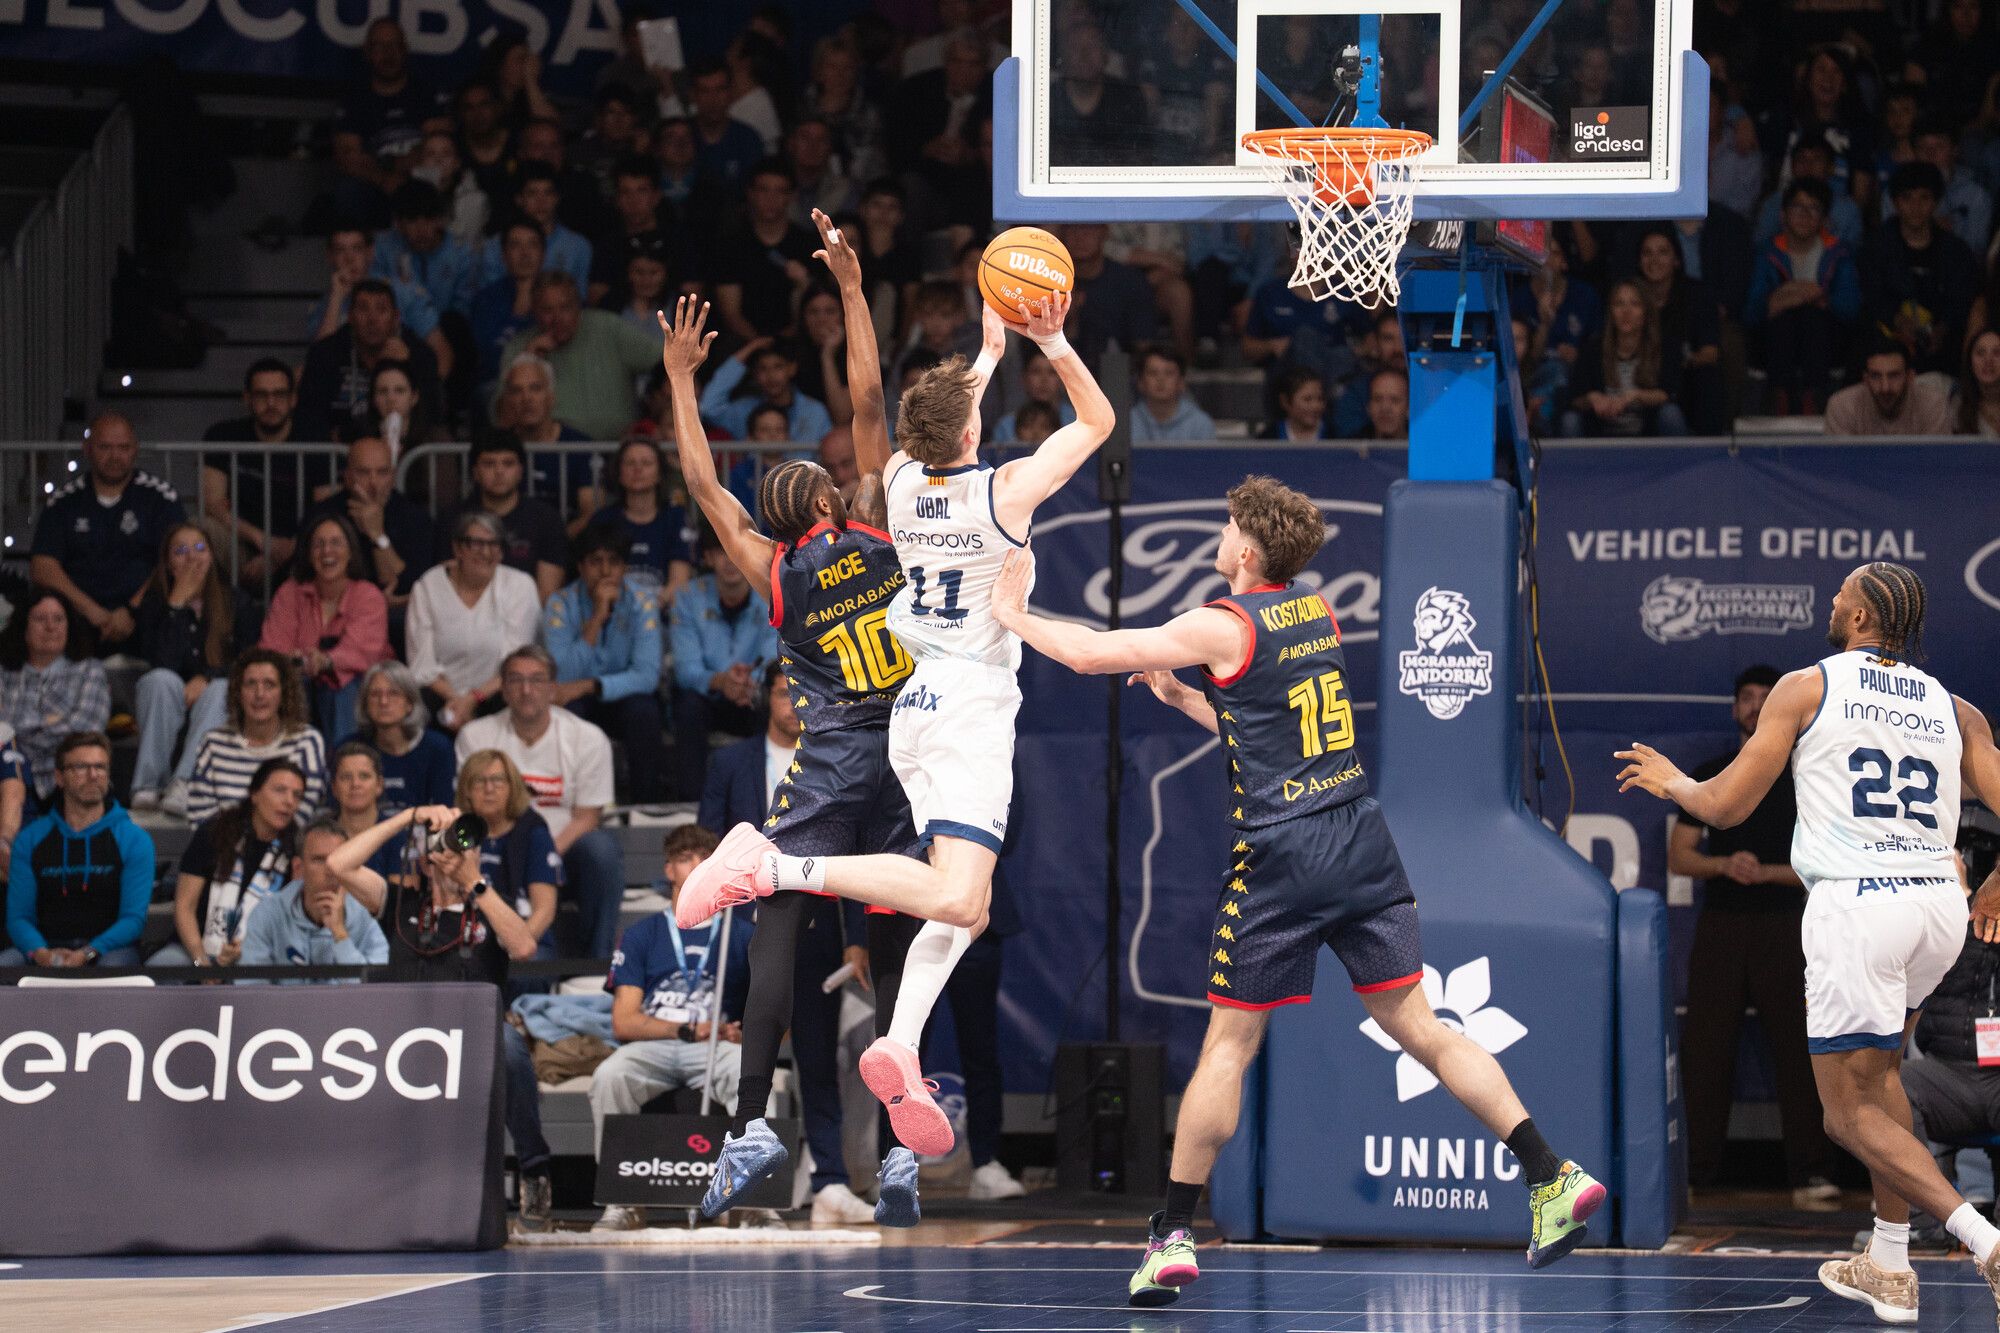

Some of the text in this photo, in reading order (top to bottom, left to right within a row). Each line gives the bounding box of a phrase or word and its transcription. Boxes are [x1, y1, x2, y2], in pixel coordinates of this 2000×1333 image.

[1574, 121, 1606, 139] liga
[1574, 137, 1644, 153] endesa
[1008, 251, 1067, 288] Wilson
[1000, 284, 1018, 300] liga
[916, 496, 951, 519] UBAL
[1567, 526, 1927, 562] VEHICLE OFICIAL
[817, 551, 867, 590] RICE
[819, 571, 906, 623] MORABANC
[909, 566, 969, 620] 11
[817, 608, 914, 691] 10
[1404, 655, 1487, 669] MORABANC
[1404, 668, 1488, 687] ANDORRA
[1859, 667, 1927, 702] PAULICAP
[1288, 670, 1355, 759] 15
[1844, 699, 1945, 735] inmoovs
[1903, 731, 1946, 745] by AVINENT
[1847, 746, 1939, 830] 22
[0, 1005, 463, 1104] endesa
[1364, 1135, 1520, 1181] UNNIC
[1393, 1187, 1489, 1211] ANDORRA
